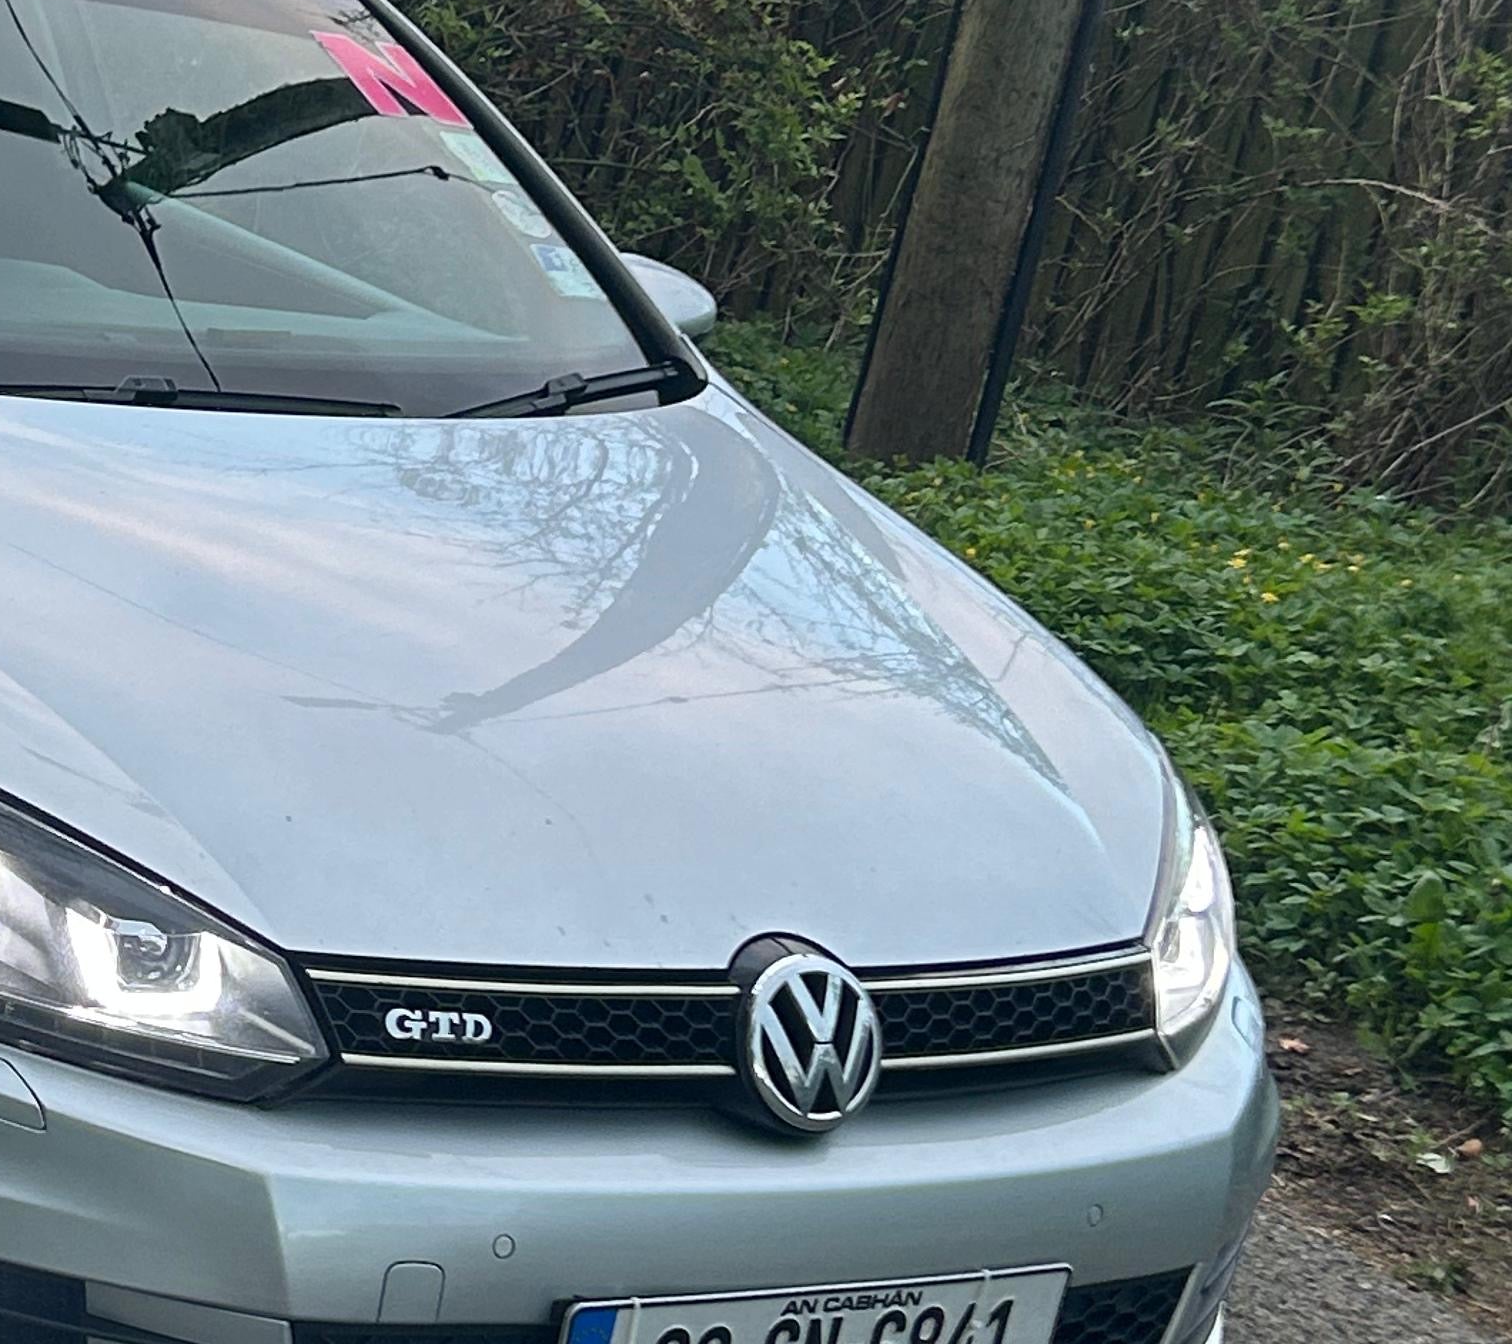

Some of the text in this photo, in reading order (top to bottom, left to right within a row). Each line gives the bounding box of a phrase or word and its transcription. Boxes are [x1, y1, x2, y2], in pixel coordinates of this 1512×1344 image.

[310, 31, 474, 129] N
[385, 1008, 492, 1043] GTD
[780, 1290, 924, 1316] AN CABHÁN
